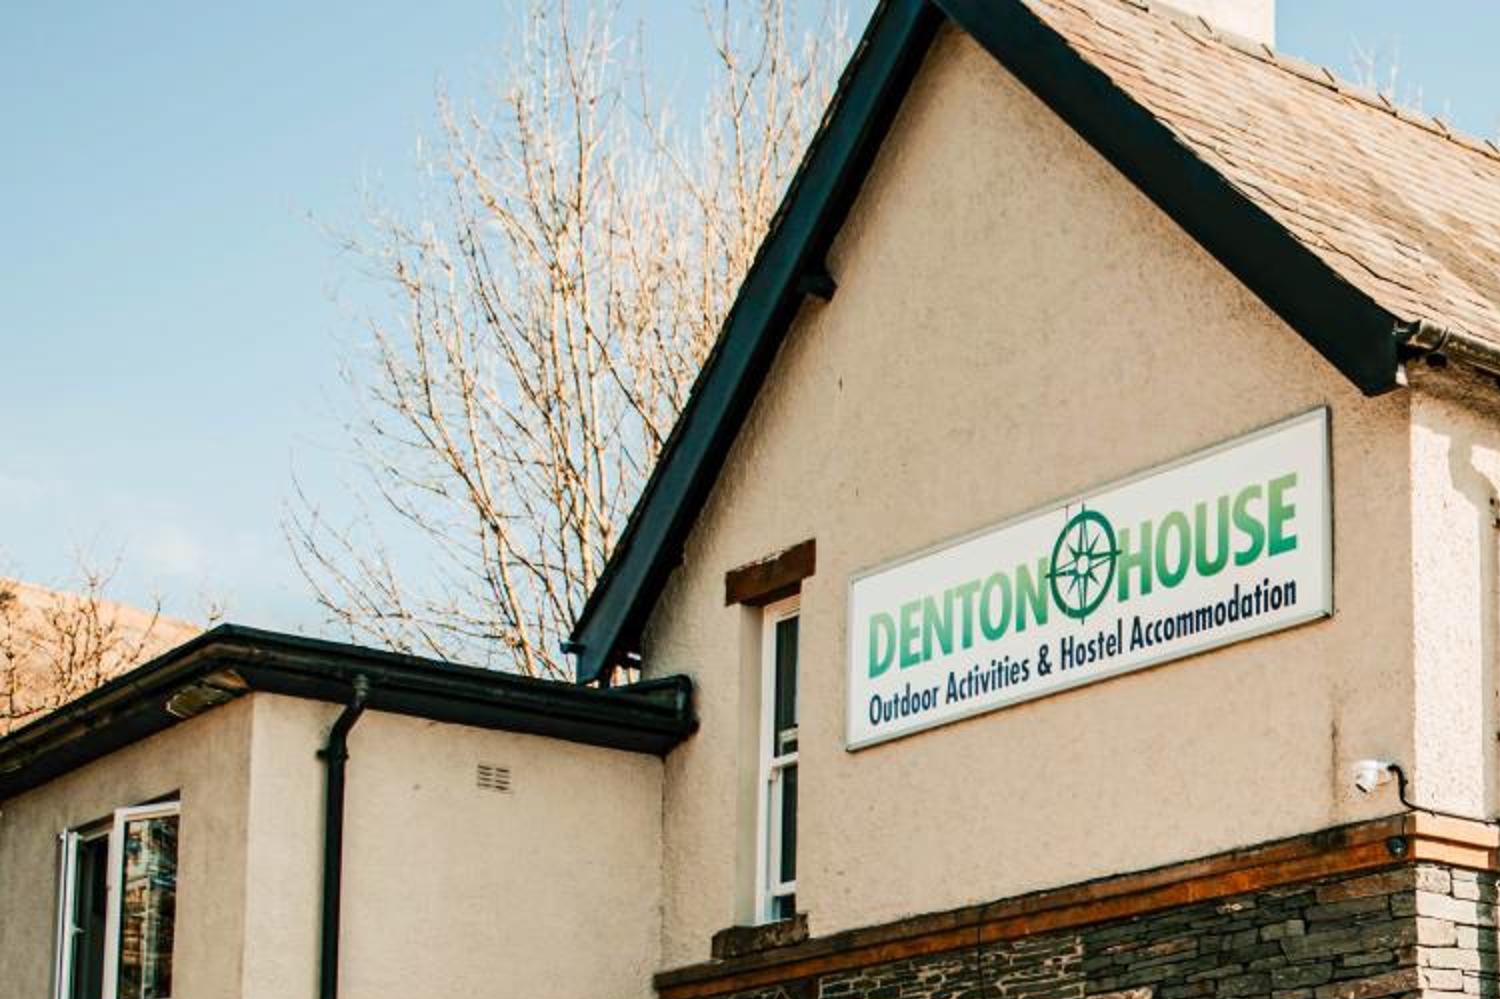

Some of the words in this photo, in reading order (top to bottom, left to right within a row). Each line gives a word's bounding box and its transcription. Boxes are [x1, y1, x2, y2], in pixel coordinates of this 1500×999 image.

[868, 556, 1049, 679] DENTON
[1116, 472, 1297, 603] HOUSE
[868, 682, 939, 726] Outdoor
[945, 654, 1030, 704] Activities
[1037, 644, 1053, 677] &
[1060, 617, 1123, 671] Hostel
[1129, 577, 1297, 651] Accommodation
